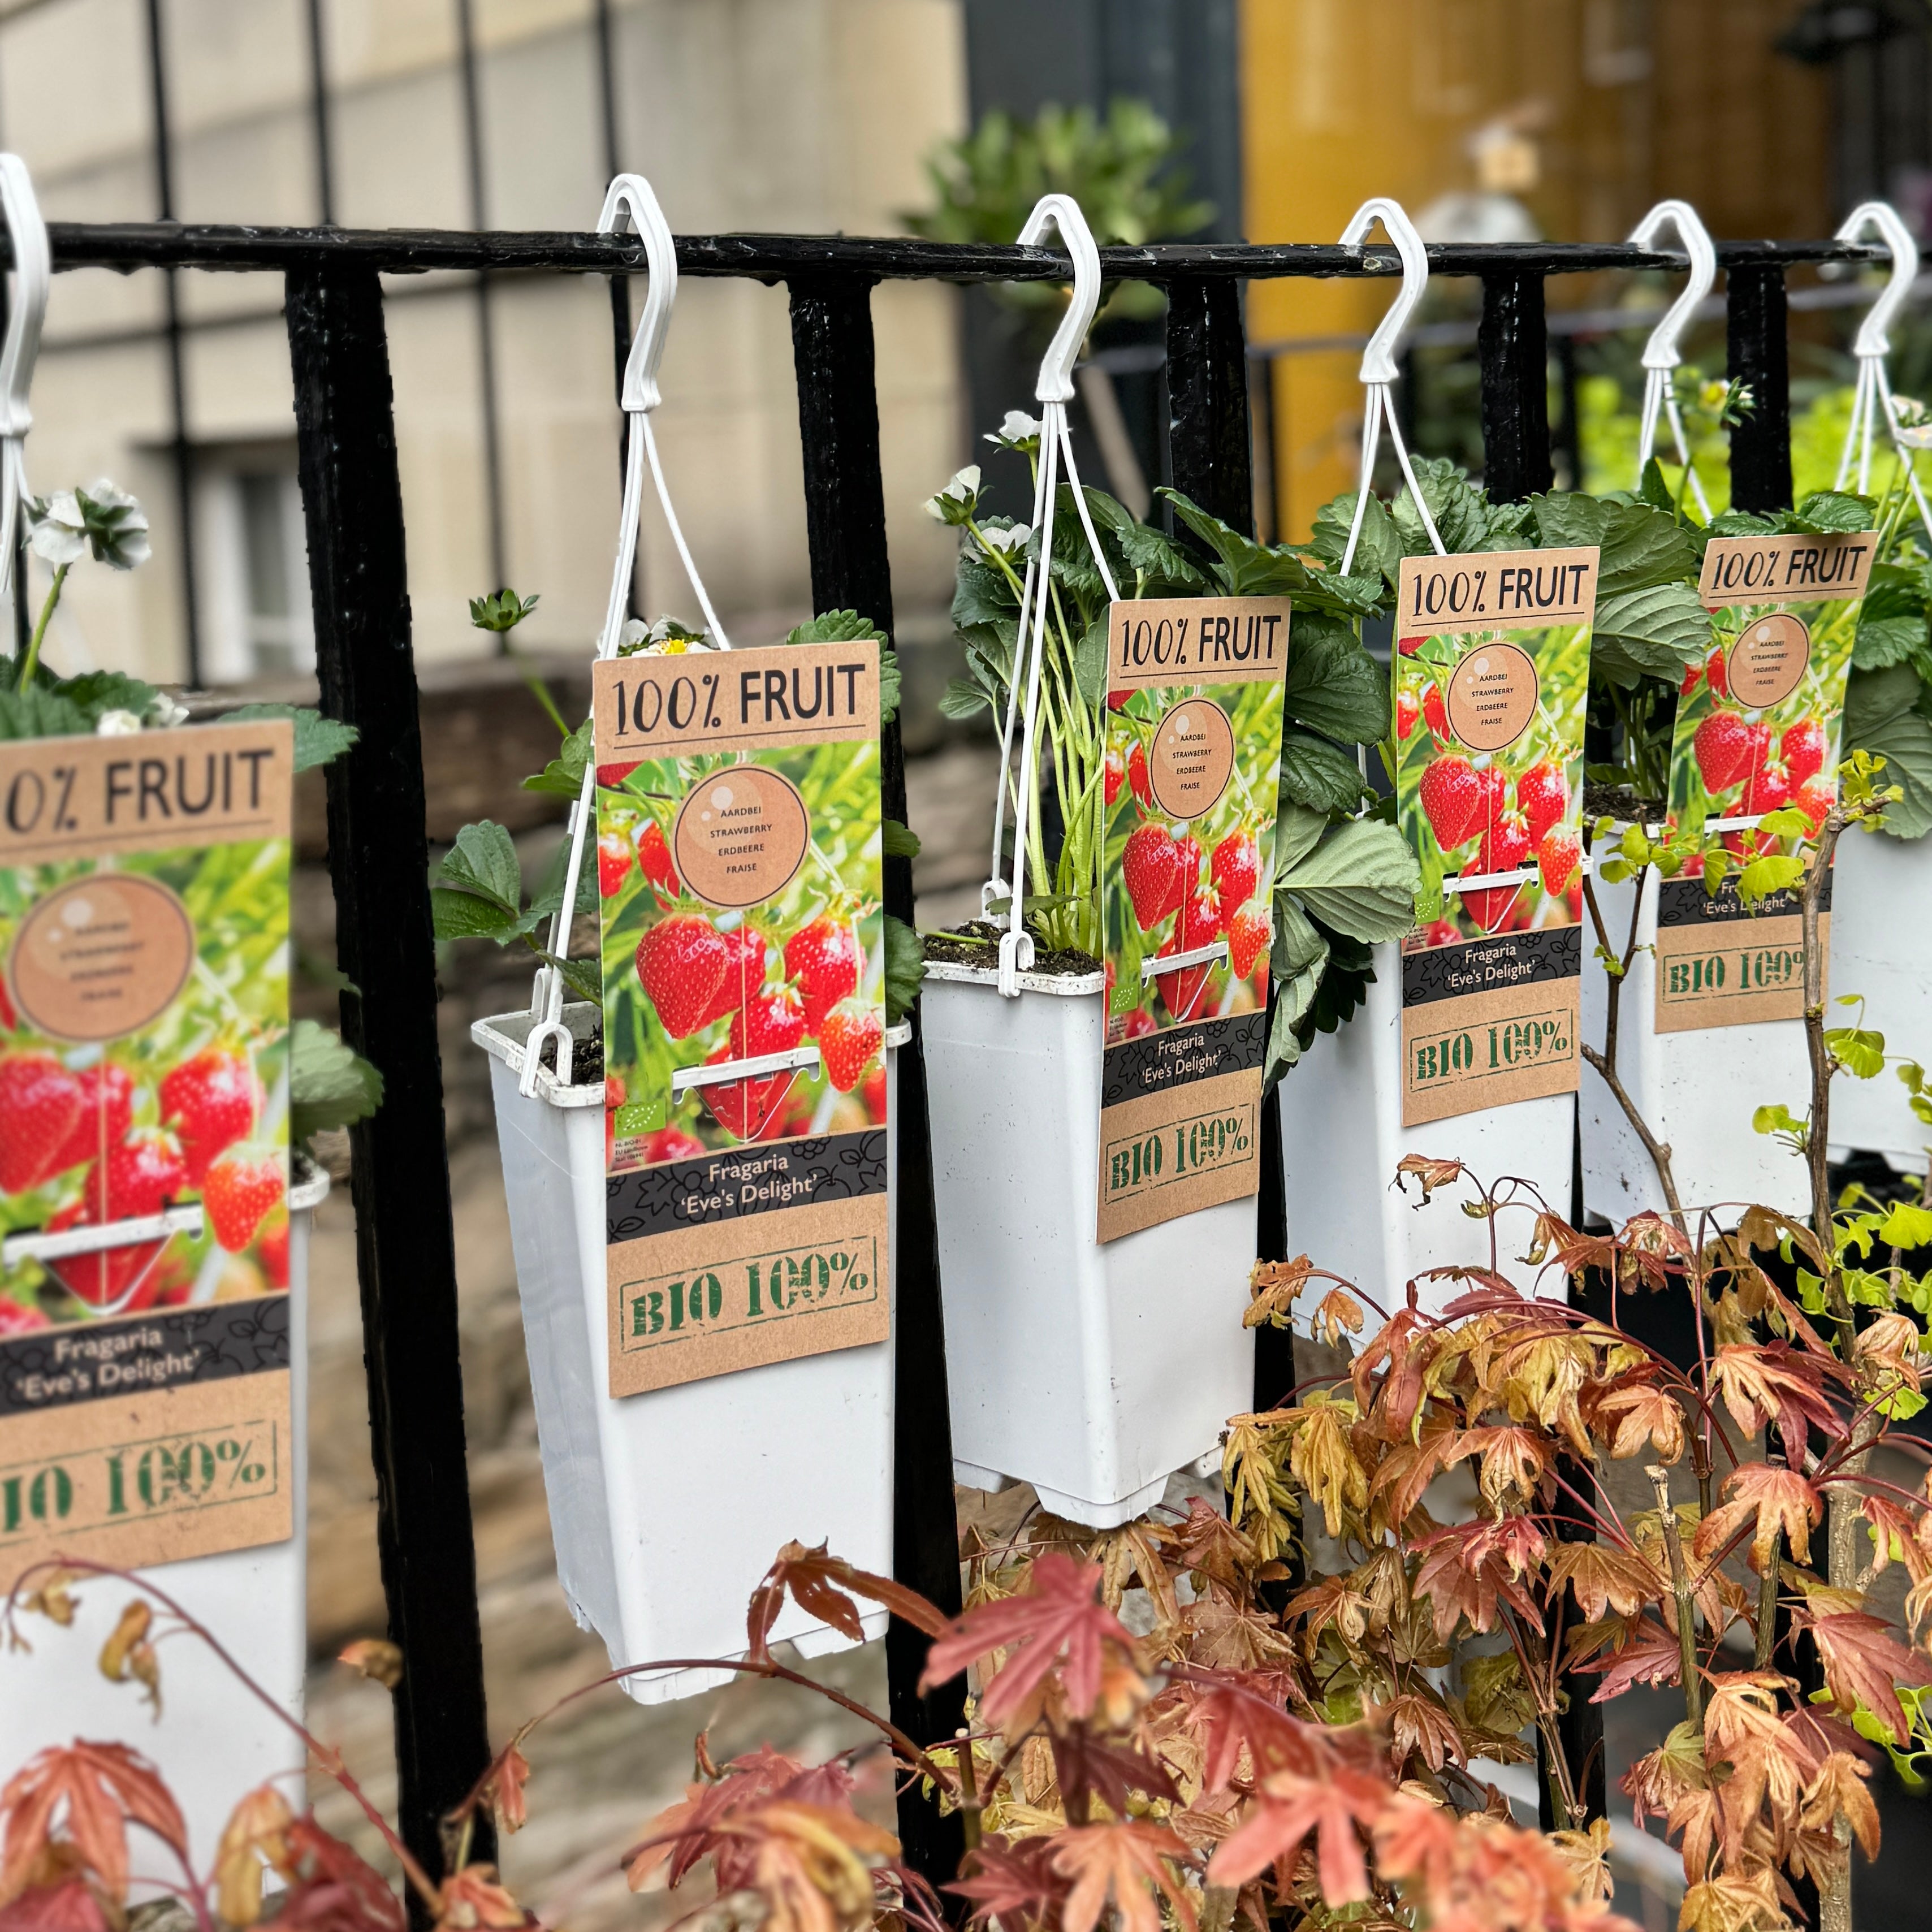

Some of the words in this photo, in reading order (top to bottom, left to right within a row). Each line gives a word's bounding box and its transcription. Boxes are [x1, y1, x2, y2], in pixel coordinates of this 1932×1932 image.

[1711, 550, 1780, 589] 100%
[1785, 546, 1868, 585] FRUIT
[1412, 570, 1487, 616] 100%
[1498, 564, 1589, 610] FRUIT
[1121, 618, 1188, 667] 100%
[1199, 615, 1282, 662] FRUIT
[1479, 673, 1507, 682] AARDBEI
[612, 674, 721, 735] 100%
[741, 664, 865, 723] FRUIT
[1472, 688, 1514, 697] STRAWBERRY
[1476, 702, 1508, 711] ERDBEERE
[1180, 733, 1206, 742] AARDBEI
[1173, 749, 1212, 758] STRAWBERRY
[1177, 765, 1206, 775] ERDBEERE
[105, 749, 275, 824] FRUIT
[720, 806, 761, 818] AARDBEI
[710, 824, 772, 838] STRAWBERRY
[718, 843, 764, 856] ERDBEERE
[727, 863, 757, 874] FRAISE
[1703, 899, 1736, 915] ‘Eve's
[1465, 943, 1516, 964] Fragaria
[1447, 969, 1481, 988] ‘Eve's
[1485, 959, 1535, 982] Delight’
[1669, 956, 1726, 993] BIO
[1157, 1032, 1204, 1057] Fragaria
[1416, 1032, 1473, 1080] BIO
[1488, 1020, 1568, 1069] 100%
[1142, 1061, 1172, 1084] ‘Eve's
[1175, 1049, 1221, 1076] Delight’
[709, 1154, 789, 1182] Fragaria
[1110, 1134, 1162, 1190] BIO
[1175, 1117, 1248, 1174] 100%
[681, 1190, 734, 1215] ‘Eve's
[742, 1174, 817, 1203] Delight’
[630, 1272, 723, 1337] BIO
[746, 1252, 868, 1317] 100%
[55, 1328, 162, 1361] Fragaria
[16, 1370, 90, 1400] ‘Eve's
[99, 1349, 201, 1385] Delight’
[106, 1440, 266, 1516] 100%
